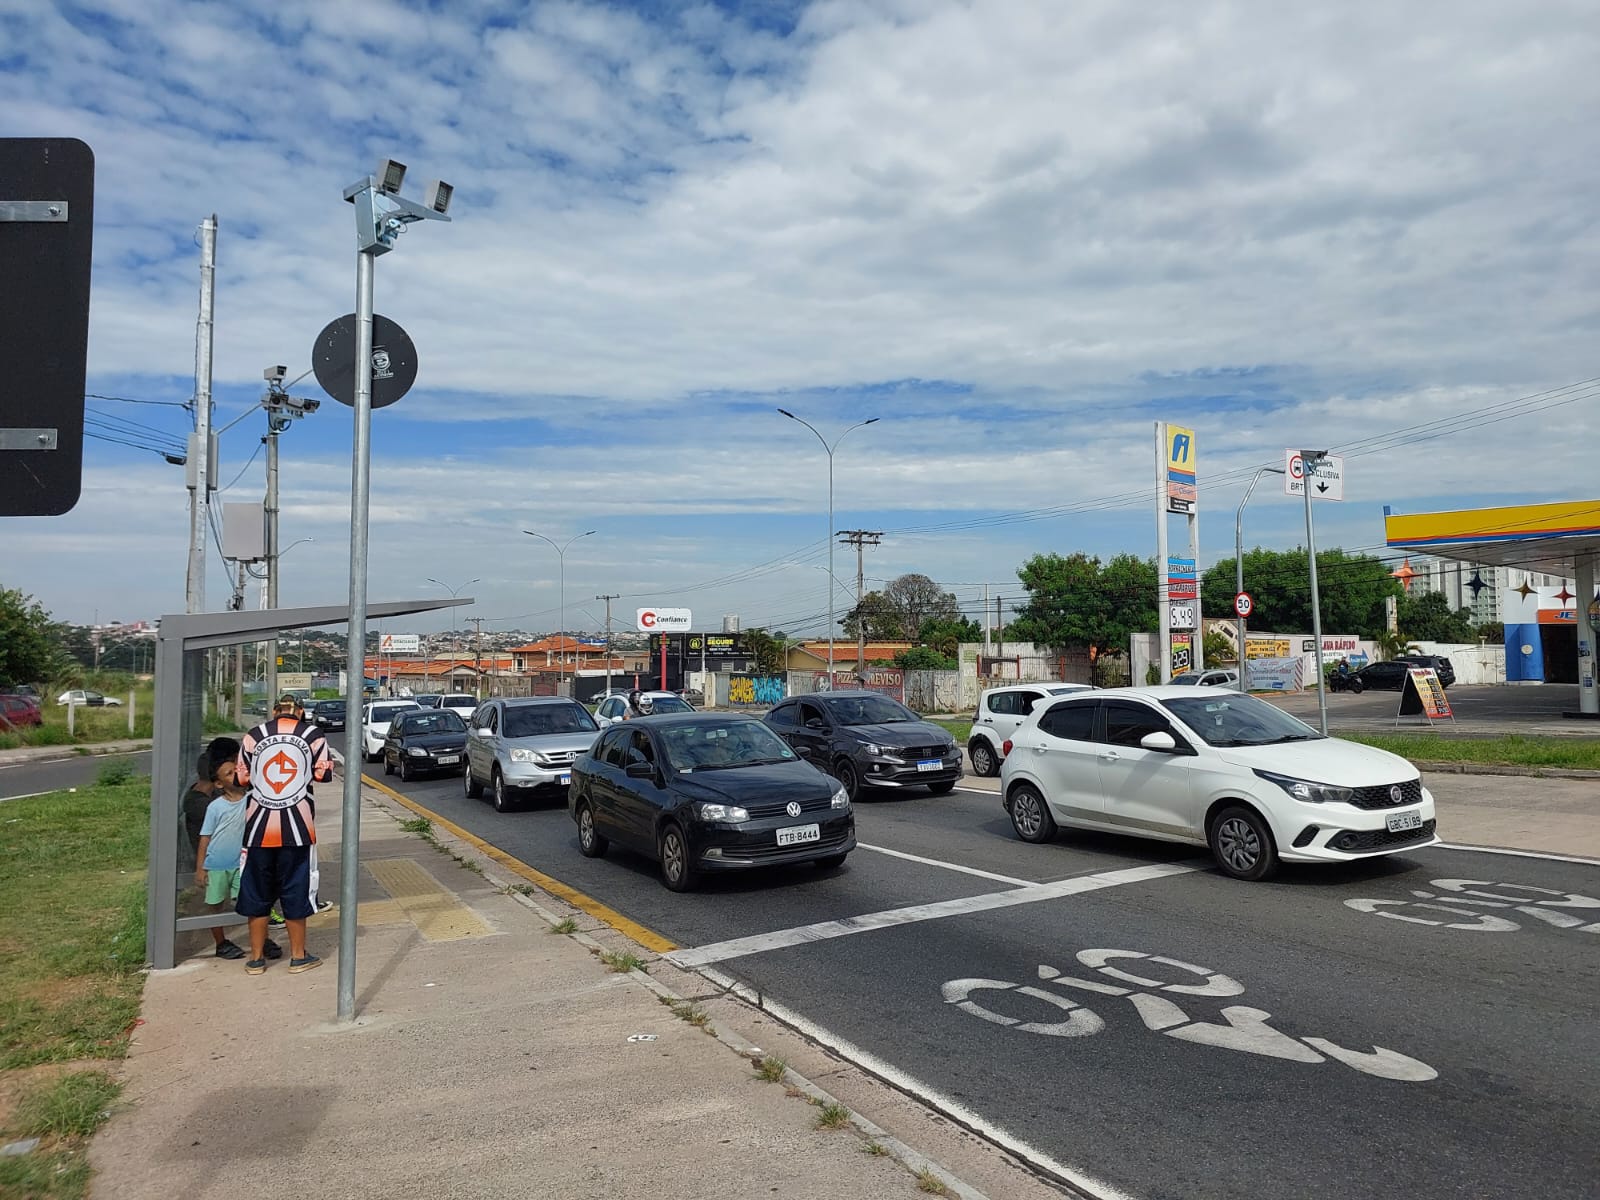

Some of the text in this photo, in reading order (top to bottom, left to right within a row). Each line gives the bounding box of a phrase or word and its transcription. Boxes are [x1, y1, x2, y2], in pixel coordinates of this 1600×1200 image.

[1237, 599, 1250, 609] 50
[656, 616, 688, 624] Confiance
[1170, 607, 1194, 626] 5,49
[1322, 640, 1333, 651] AVA
[253, 736, 278, 757] COSTA
[290, 736, 309, 755] SILVA
